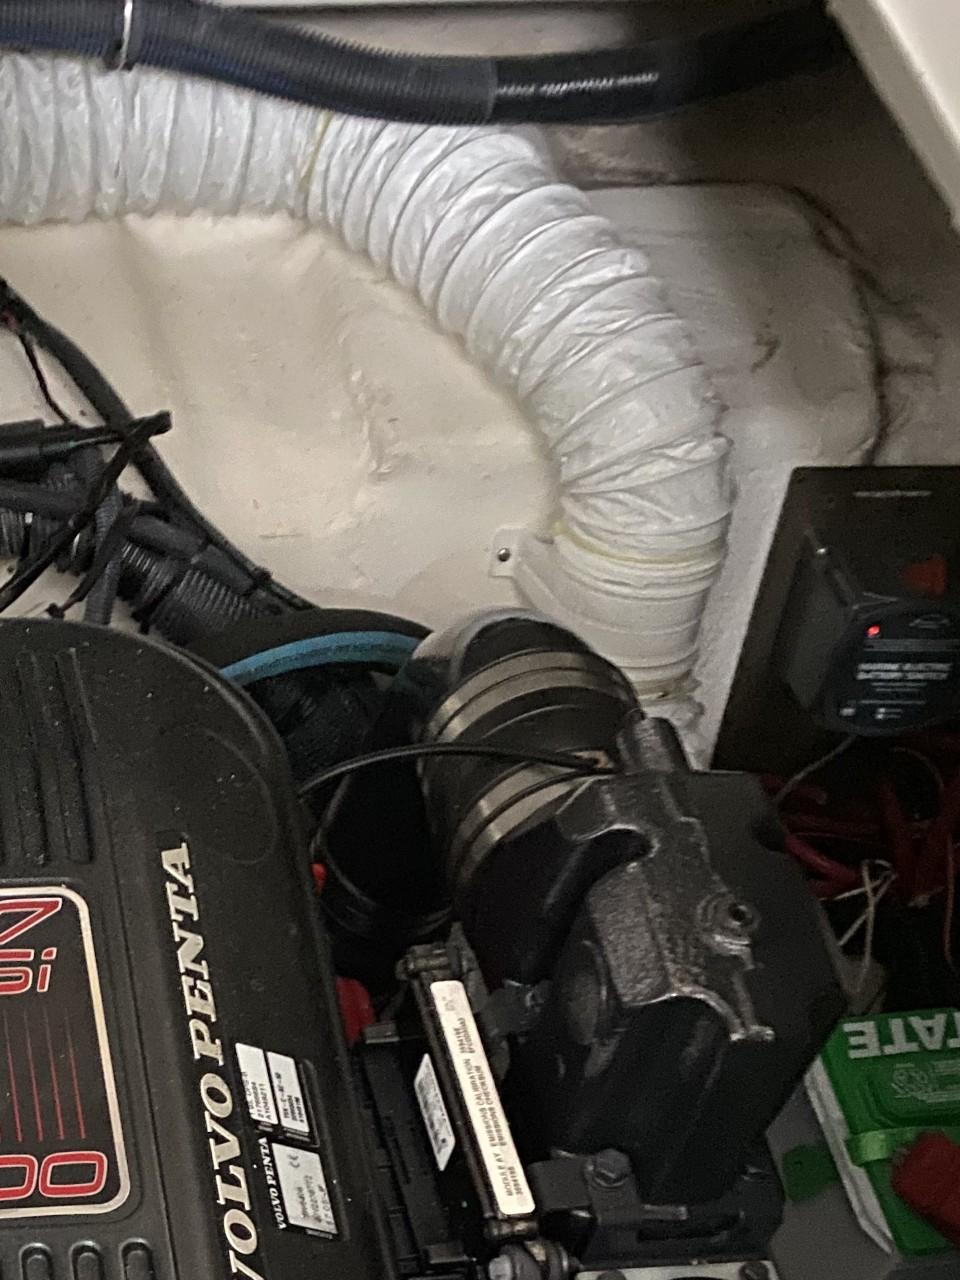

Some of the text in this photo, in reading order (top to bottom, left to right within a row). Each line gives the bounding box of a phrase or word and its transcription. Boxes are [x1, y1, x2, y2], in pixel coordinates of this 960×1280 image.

[161, 842, 224, 1066] PENTA
[463, 1059, 484, 1105] CALIBRATION
[479, 1107, 498, 1147] EMISSIONS
[258, 1137, 278, 1187] PENTA
[268, 1188, 287, 1230] VOLVO
